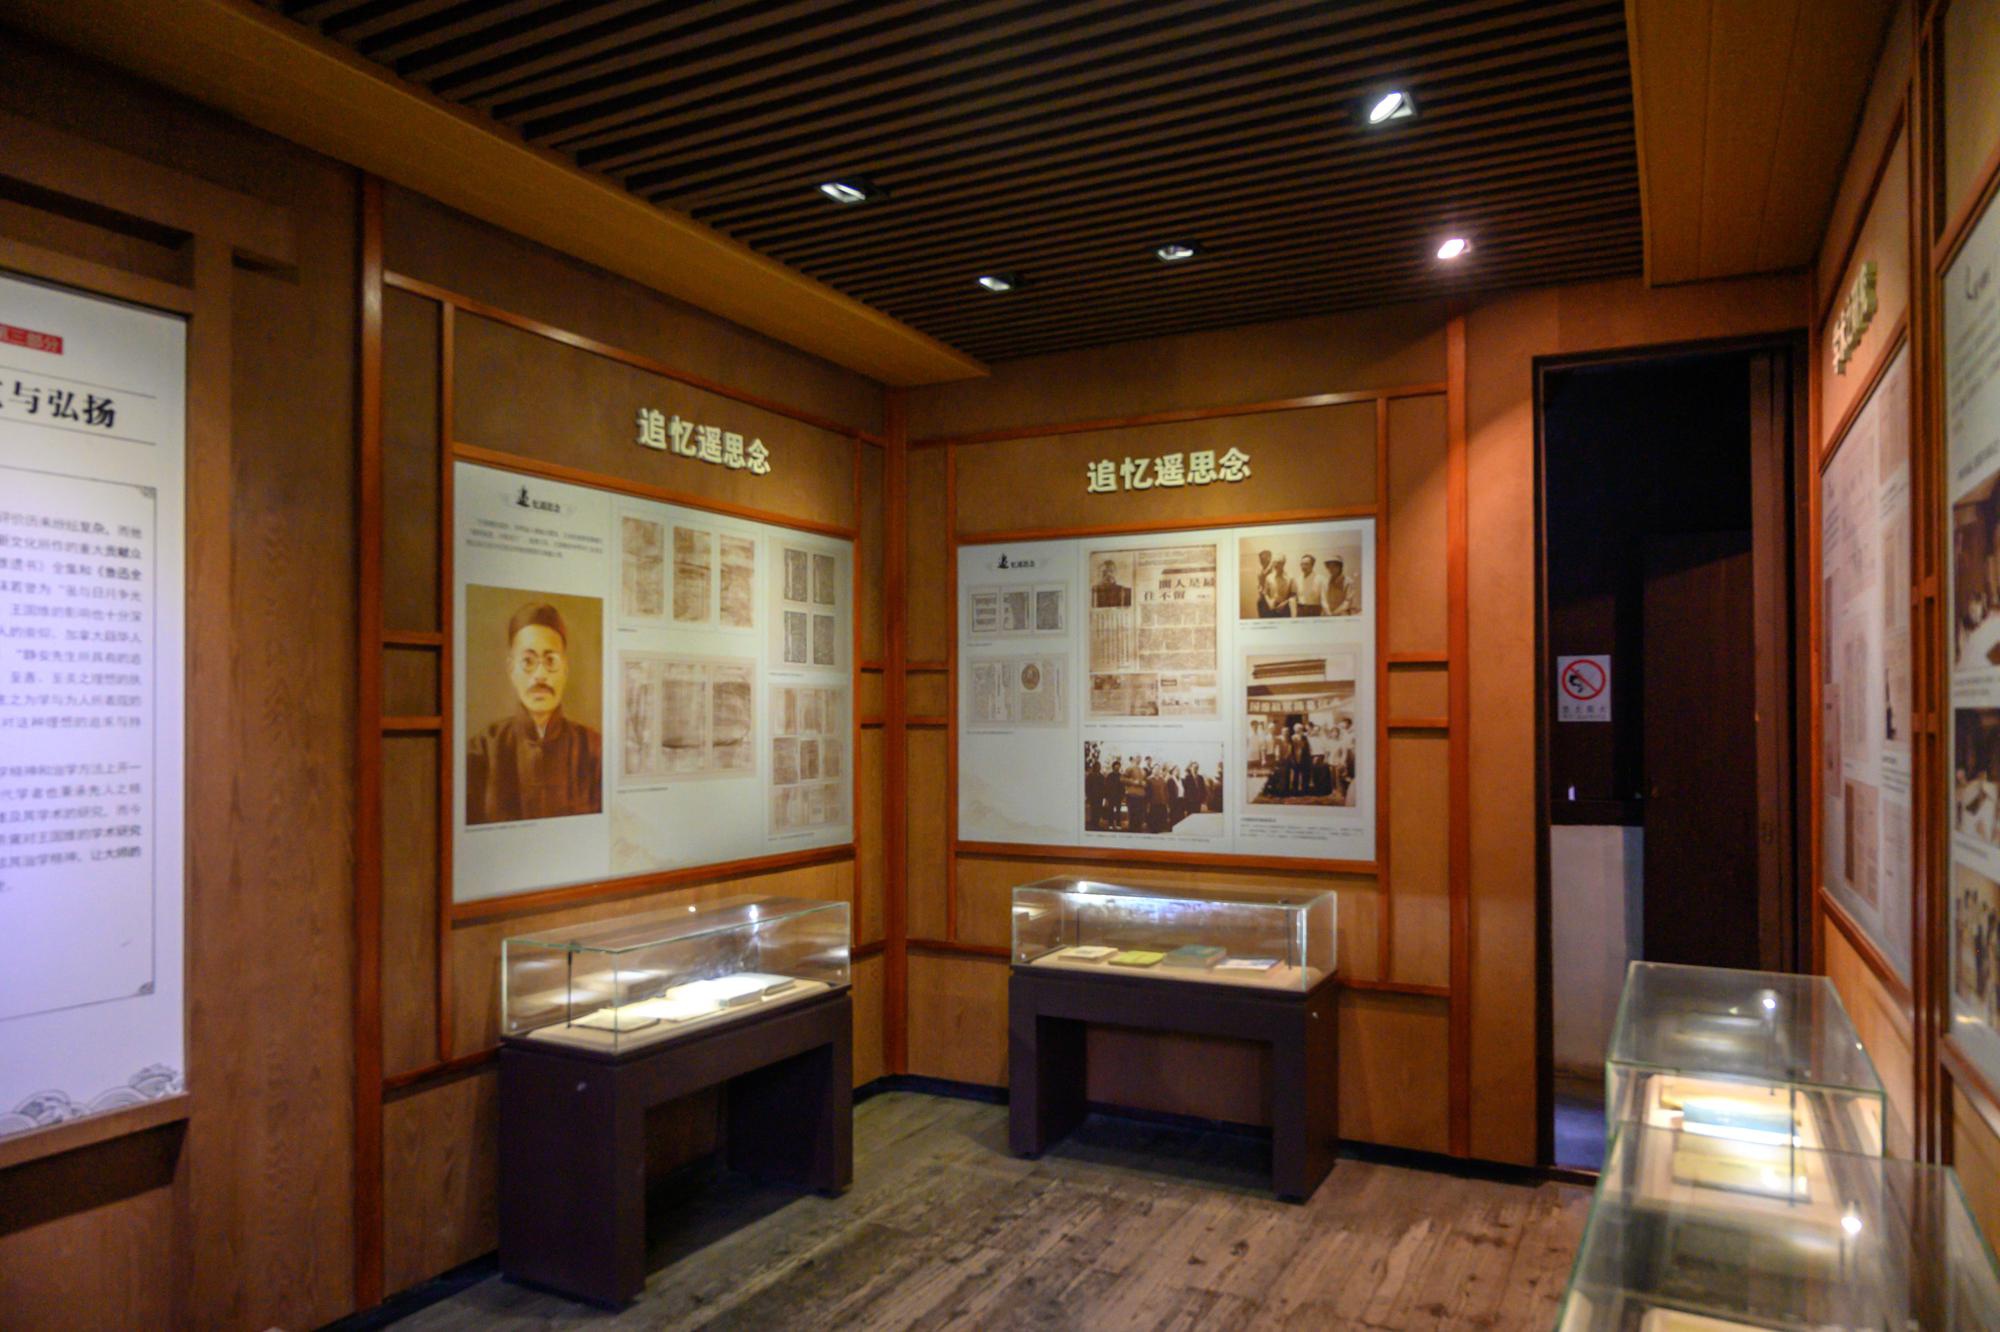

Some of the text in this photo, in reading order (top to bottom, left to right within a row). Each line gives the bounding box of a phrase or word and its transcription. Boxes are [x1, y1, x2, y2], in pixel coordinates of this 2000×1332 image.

[0, 380, 116, 428] 与弘扬
[636, 407, 771, 475] 追忆遥思念
[1086, 447, 1251, 493] 追忆遥思念
